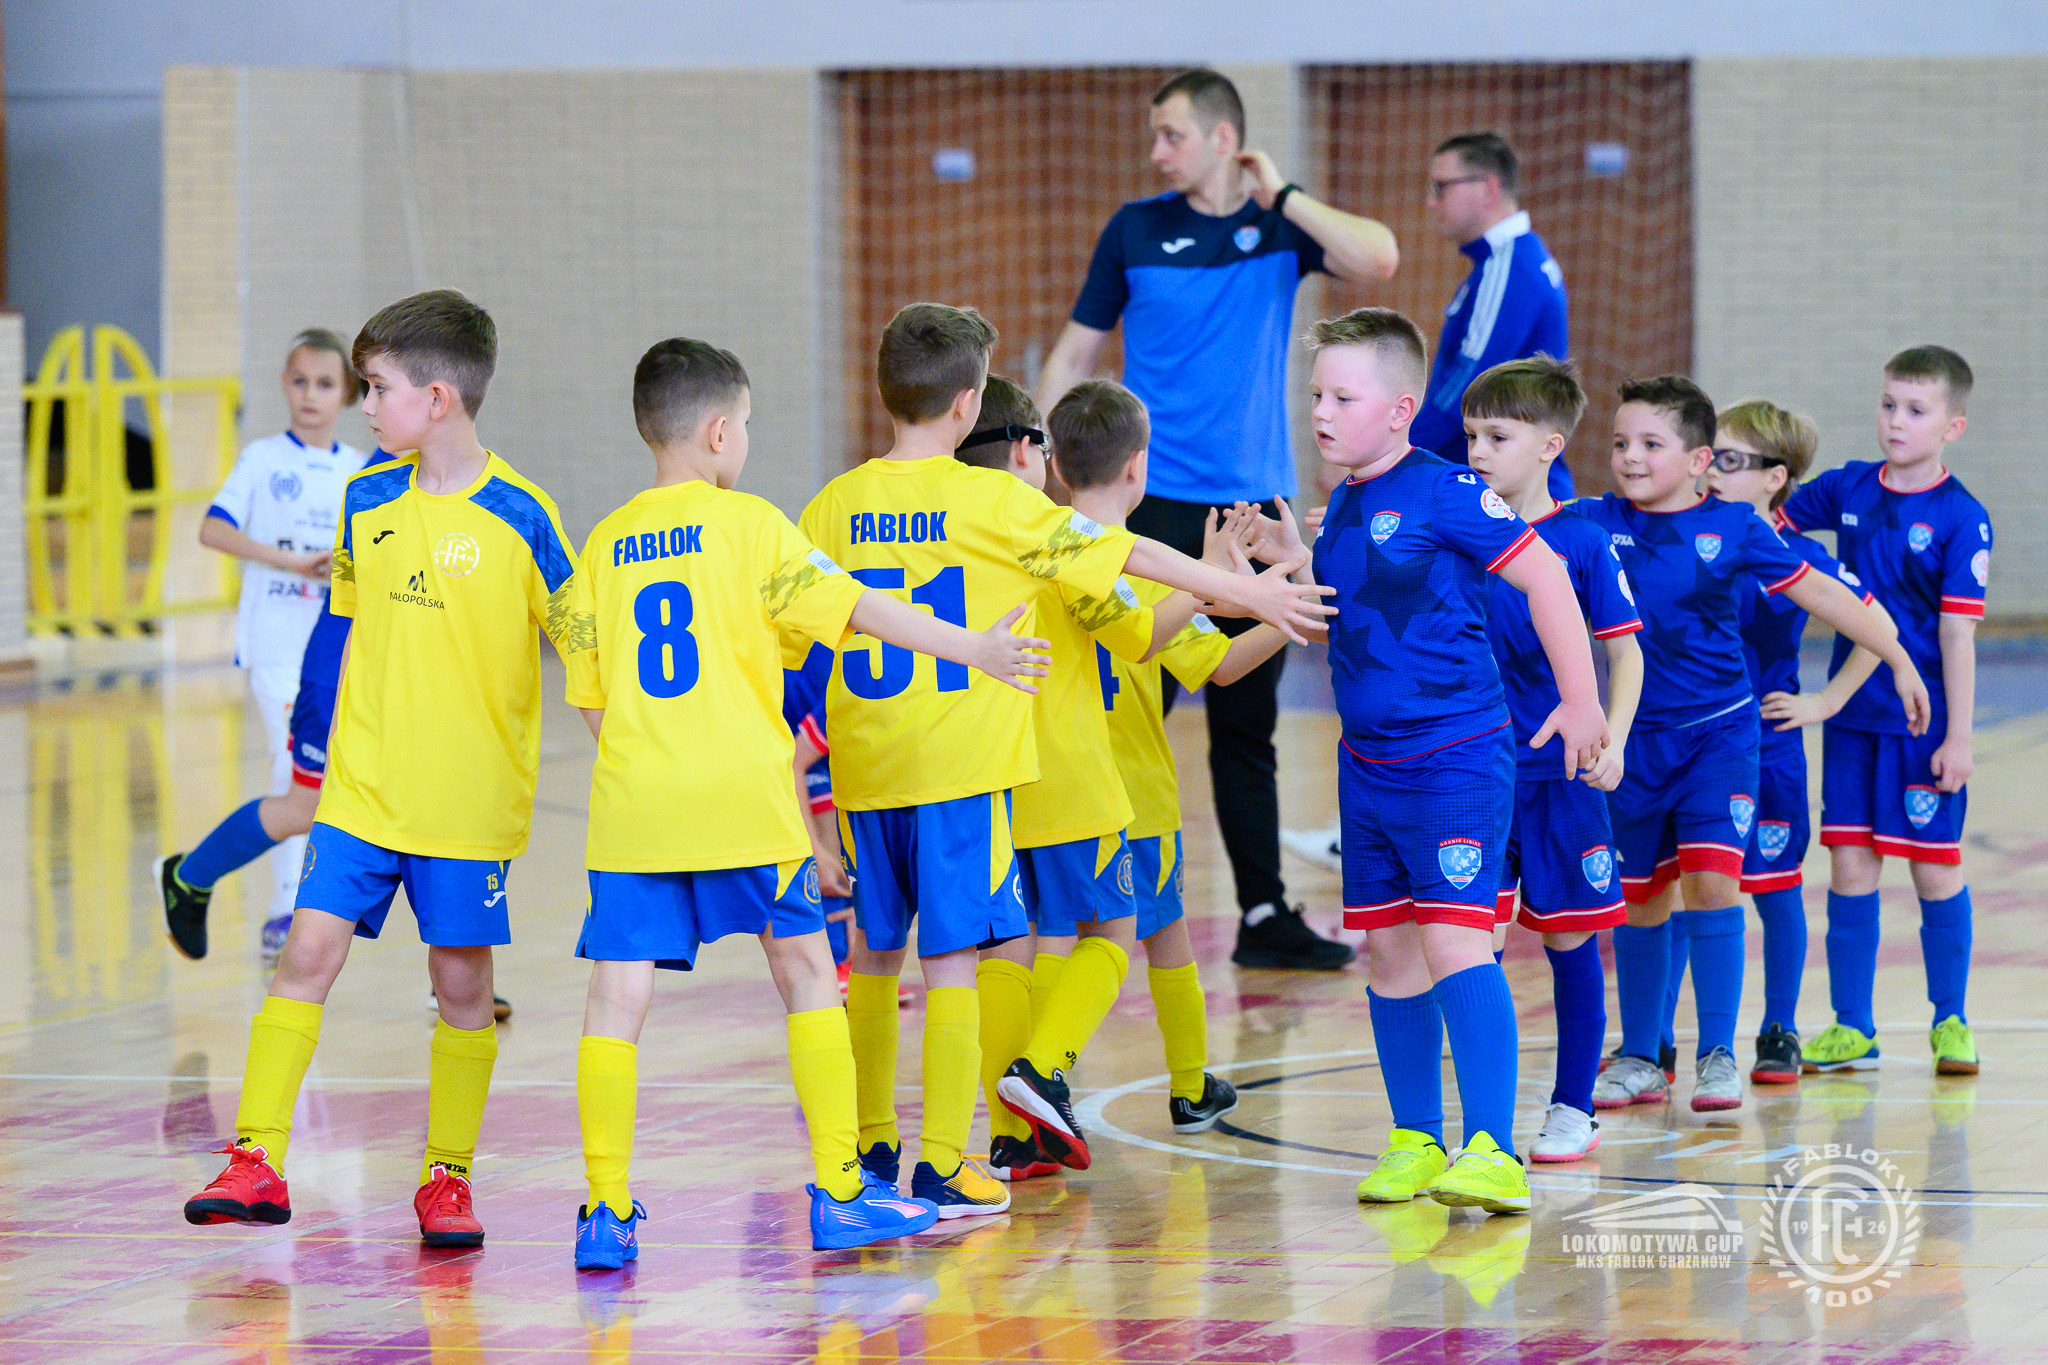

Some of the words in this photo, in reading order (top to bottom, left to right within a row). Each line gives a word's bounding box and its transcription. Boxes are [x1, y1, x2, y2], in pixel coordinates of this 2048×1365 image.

[613, 525, 703, 567] FABLOK
[850, 511, 947, 545] FABLOK
[634, 581, 699, 698] 8
[843, 566, 969, 700] 51
[486, 873, 498, 890] 15
